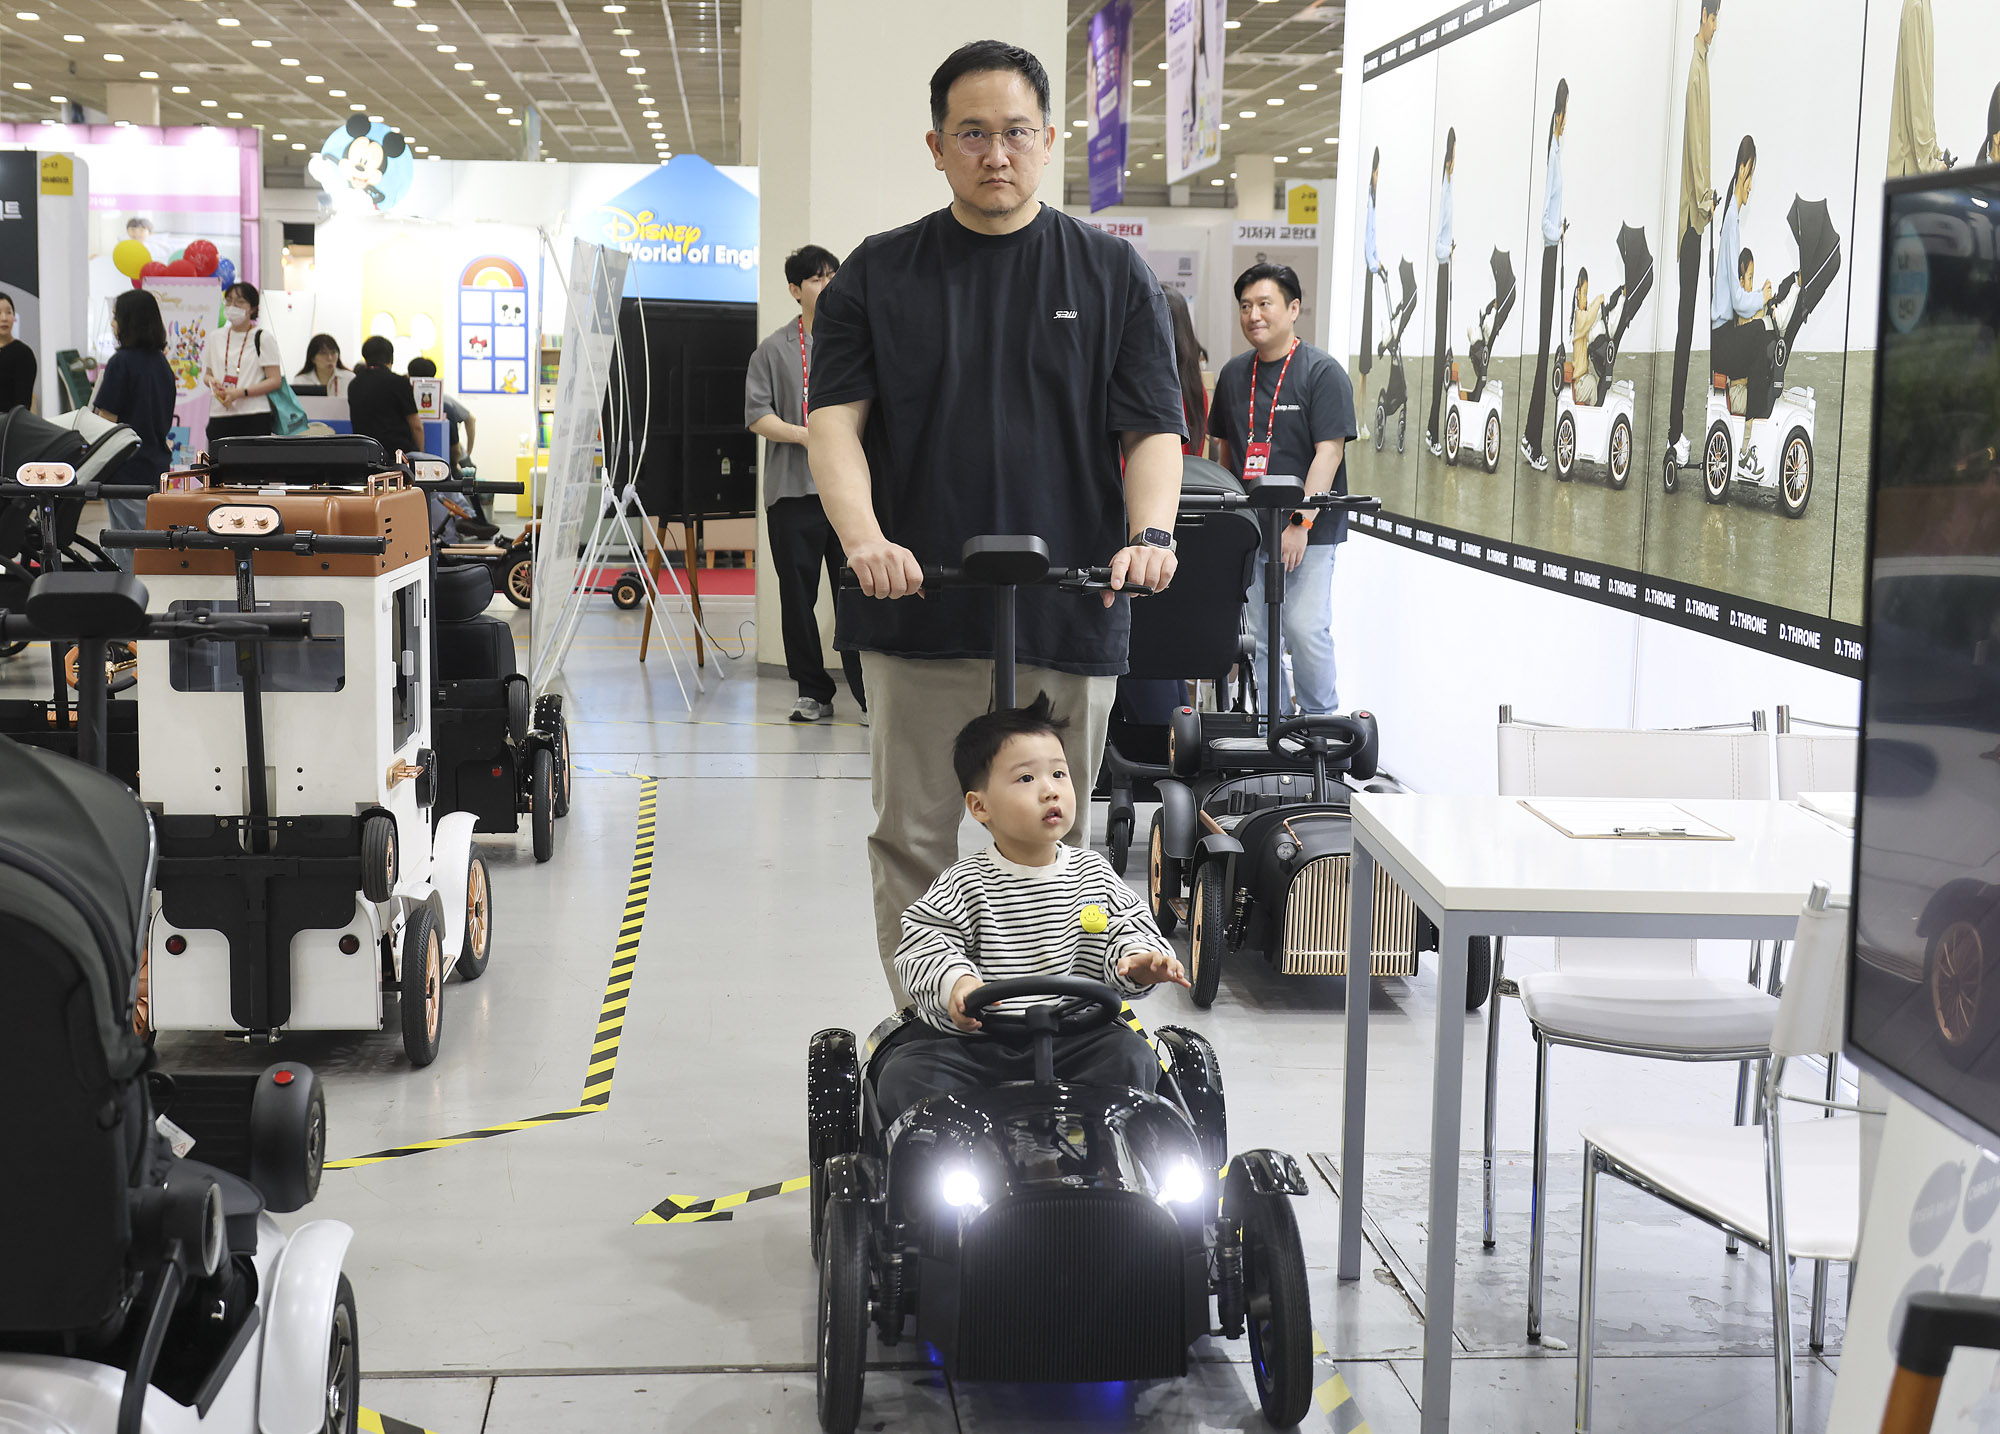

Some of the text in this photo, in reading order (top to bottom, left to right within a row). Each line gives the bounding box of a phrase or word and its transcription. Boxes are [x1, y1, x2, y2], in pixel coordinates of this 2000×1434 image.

[599, 205, 701, 254] Disney
[1239, 226, 1317, 240] 기저귀 교환대
[619, 242, 682, 264] World
[687, 244, 710, 264] of
[1543, 563, 1567, 581] D.THRONE
[1574, 571, 1600, 589] D.THRONE
[1609, 579, 1636, 598] D.THRONE
[1645, 588, 1675, 609] D.THRONE
[1686, 598, 1719, 621] D.THRONE
[1730, 610, 1767, 634] D.THRONE
[1780, 624, 1820, 649] D.THRONE
[1835, 638, 1864, 661] D.THR
